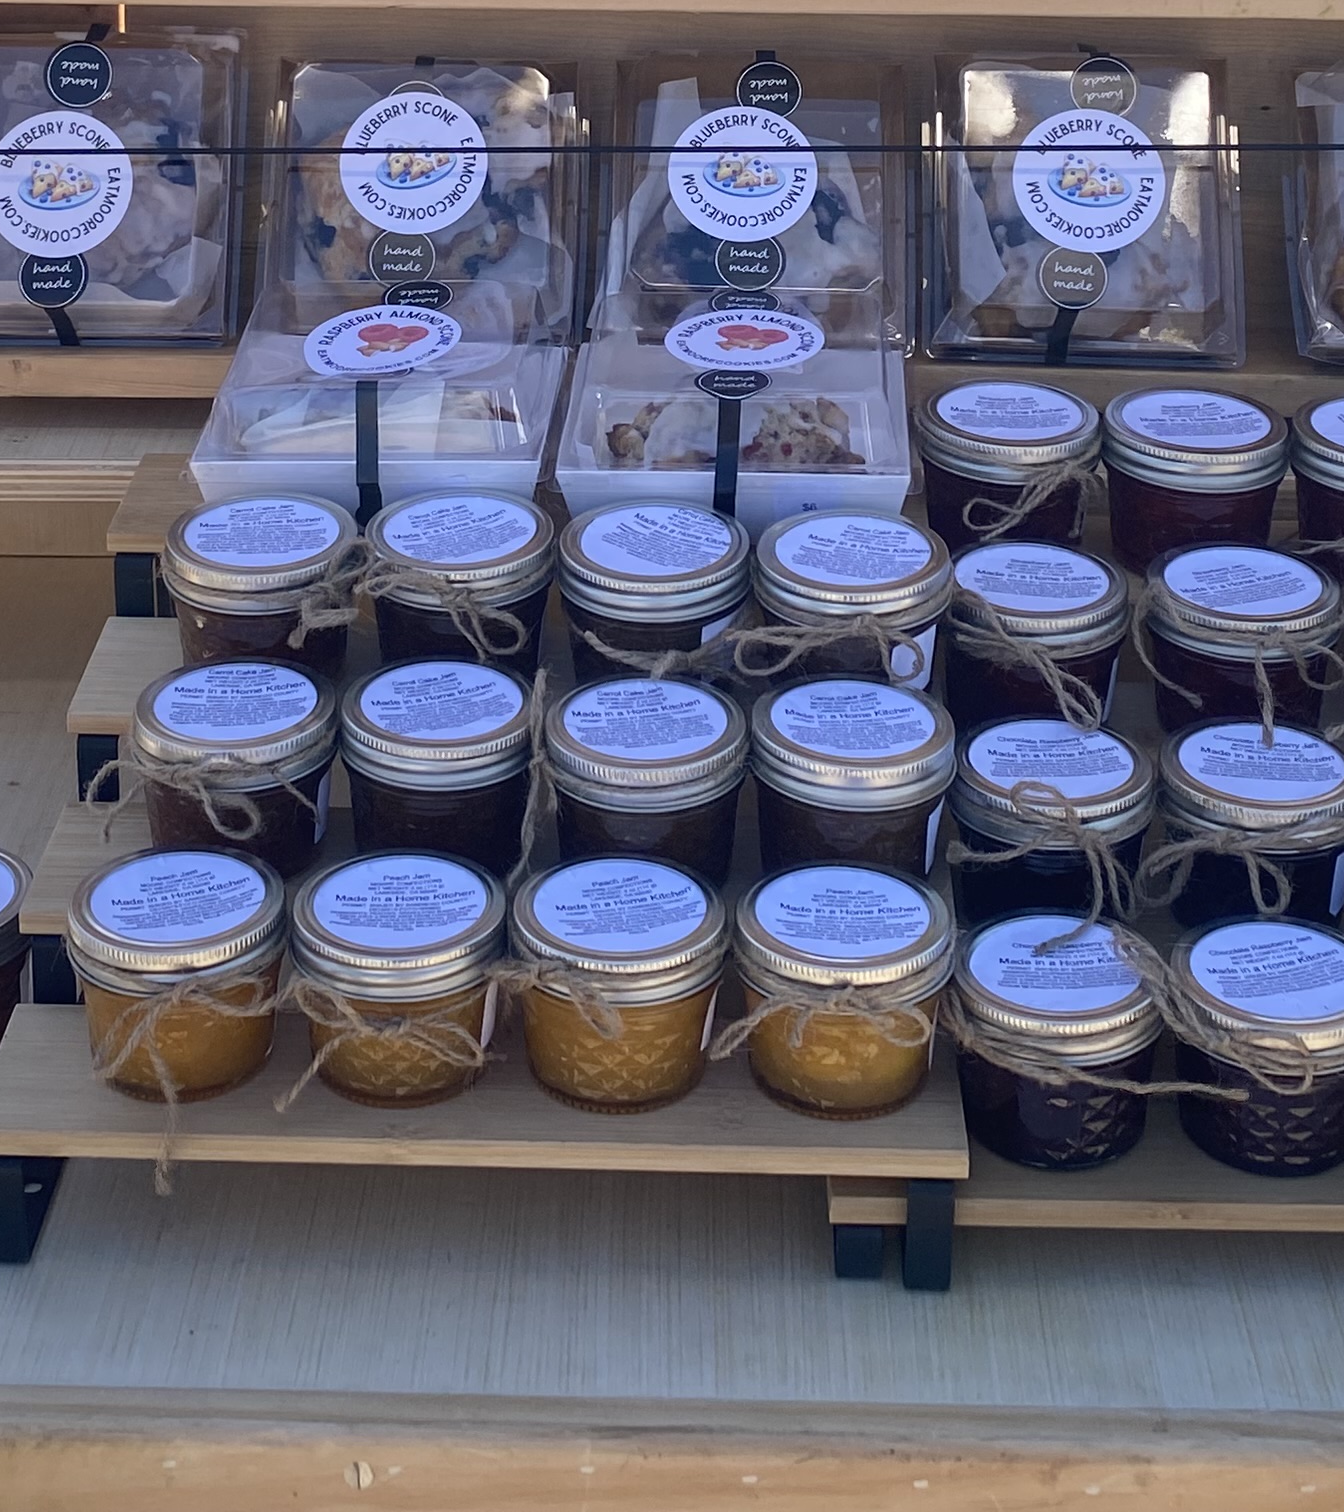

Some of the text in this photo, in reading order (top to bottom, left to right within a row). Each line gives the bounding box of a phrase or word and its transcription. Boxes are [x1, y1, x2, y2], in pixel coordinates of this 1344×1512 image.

[61, 60, 99, 71] made
[60, 76, 98, 89] hand
[749, 79, 788, 90] made
[749, 93, 788, 104] hand
[414, 101, 458, 126] SCONE
[690, 114, 801, 149] BLUEBERRY SCONE
[682, 168, 806, 227] EATMOORECOOKIES.COM
[1026, 177, 1154, 239] EATMOORECOOKIES.COM
[383, 243, 424, 257] hand
[729, 247, 769, 259] hand
[33, 261, 73, 274] hand
[382, 261, 423, 272] made
[729, 263, 769, 274] made
[1054, 262, 1095, 277] hand
[32, 278, 72, 289] made
[1053, 279, 1094, 292] made
[320, 311, 443, 346] RASPBERRY ALMOND
[678, 313, 802, 340] RASPBERRY ALMOND
[266, 682, 306, 692] Kitchen
[171, 889, 205, 900] Home
[208, 876, 250, 893] Kitchen
[335, 894, 368, 902] Made
[433, 889, 475, 900] Kitchen
[1207, 967, 1238, 975] Made
[1241, 965, 1250, 974] in
[1263, 960, 1296, 971] Home
[1299, 949, 1339, 964] Kitchen
